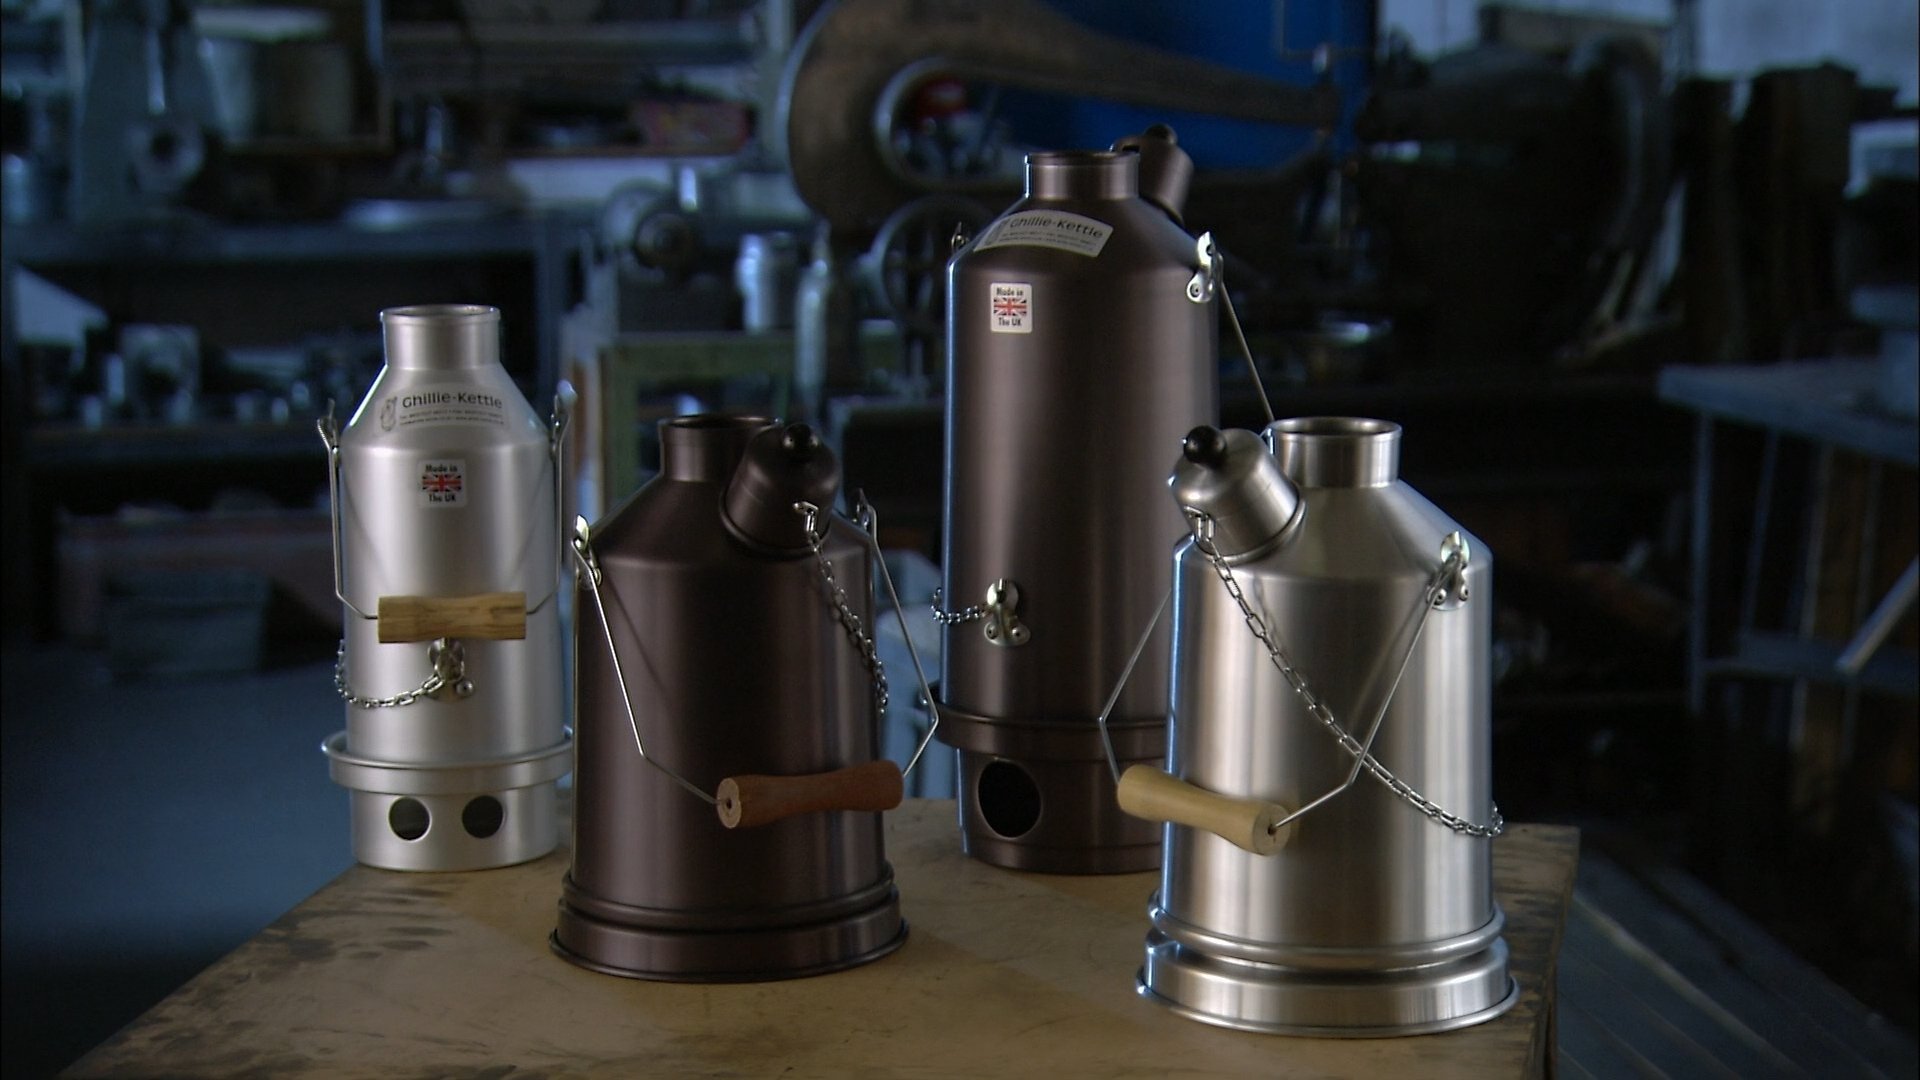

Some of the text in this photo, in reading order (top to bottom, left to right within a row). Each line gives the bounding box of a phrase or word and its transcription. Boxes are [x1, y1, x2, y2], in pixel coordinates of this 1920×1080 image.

[996, 287, 1015, 296] Made
[998, 317, 1022, 326] The UK
[402, 391, 503, 409] Ghillie-Kettle
[428, 492, 457, 502] The UK
